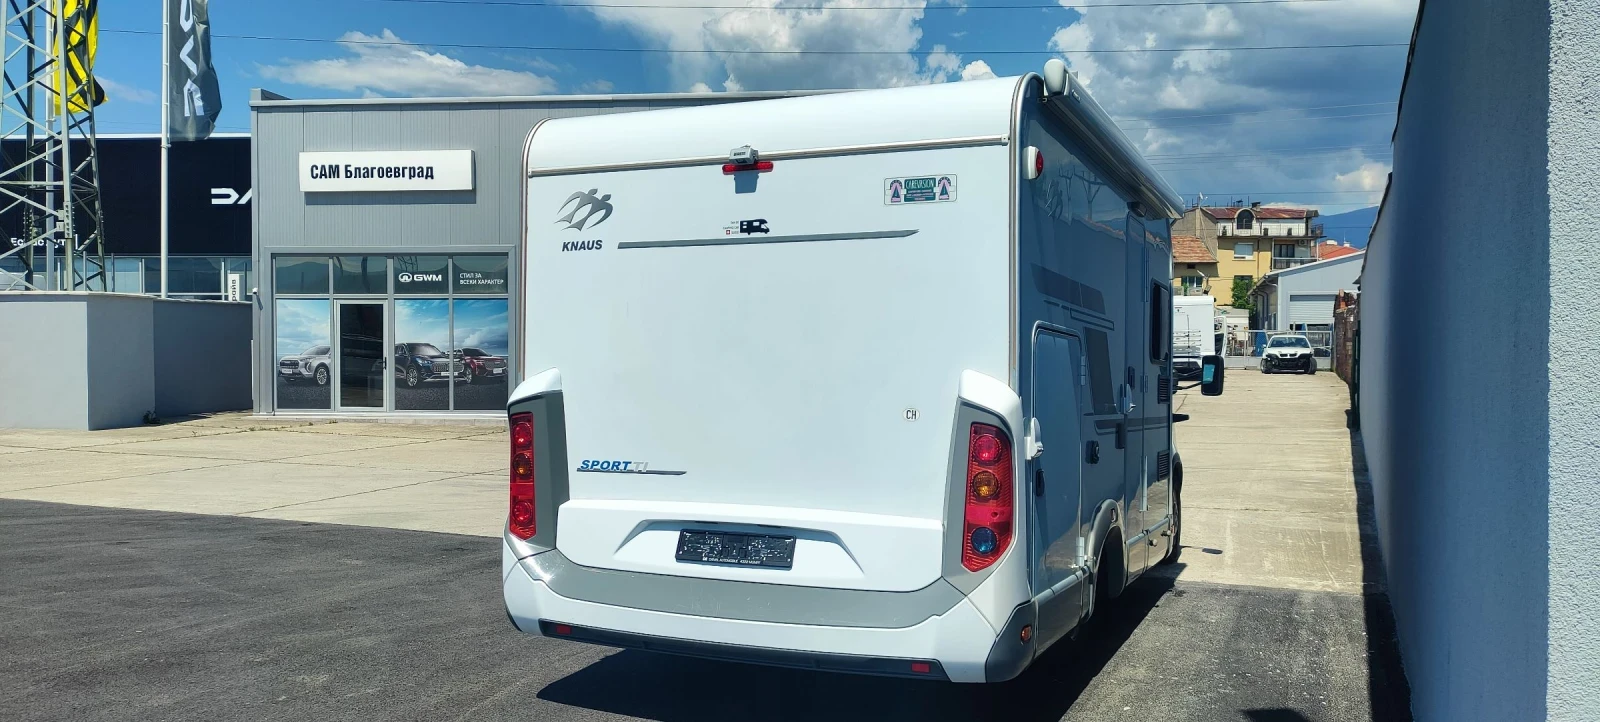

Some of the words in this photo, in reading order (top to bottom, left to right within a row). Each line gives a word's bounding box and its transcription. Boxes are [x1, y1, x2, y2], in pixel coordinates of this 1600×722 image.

[310, 164, 340, 179] САМ
[344, 164, 434, 180] Благоевград
[561, 239, 603, 252] KNAUS
[413, 274, 442, 282] GWM
[906, 409, 917, 420] CH
[580, 459, 632, 471] SPORT
[632, 461, 649, 472] TI
